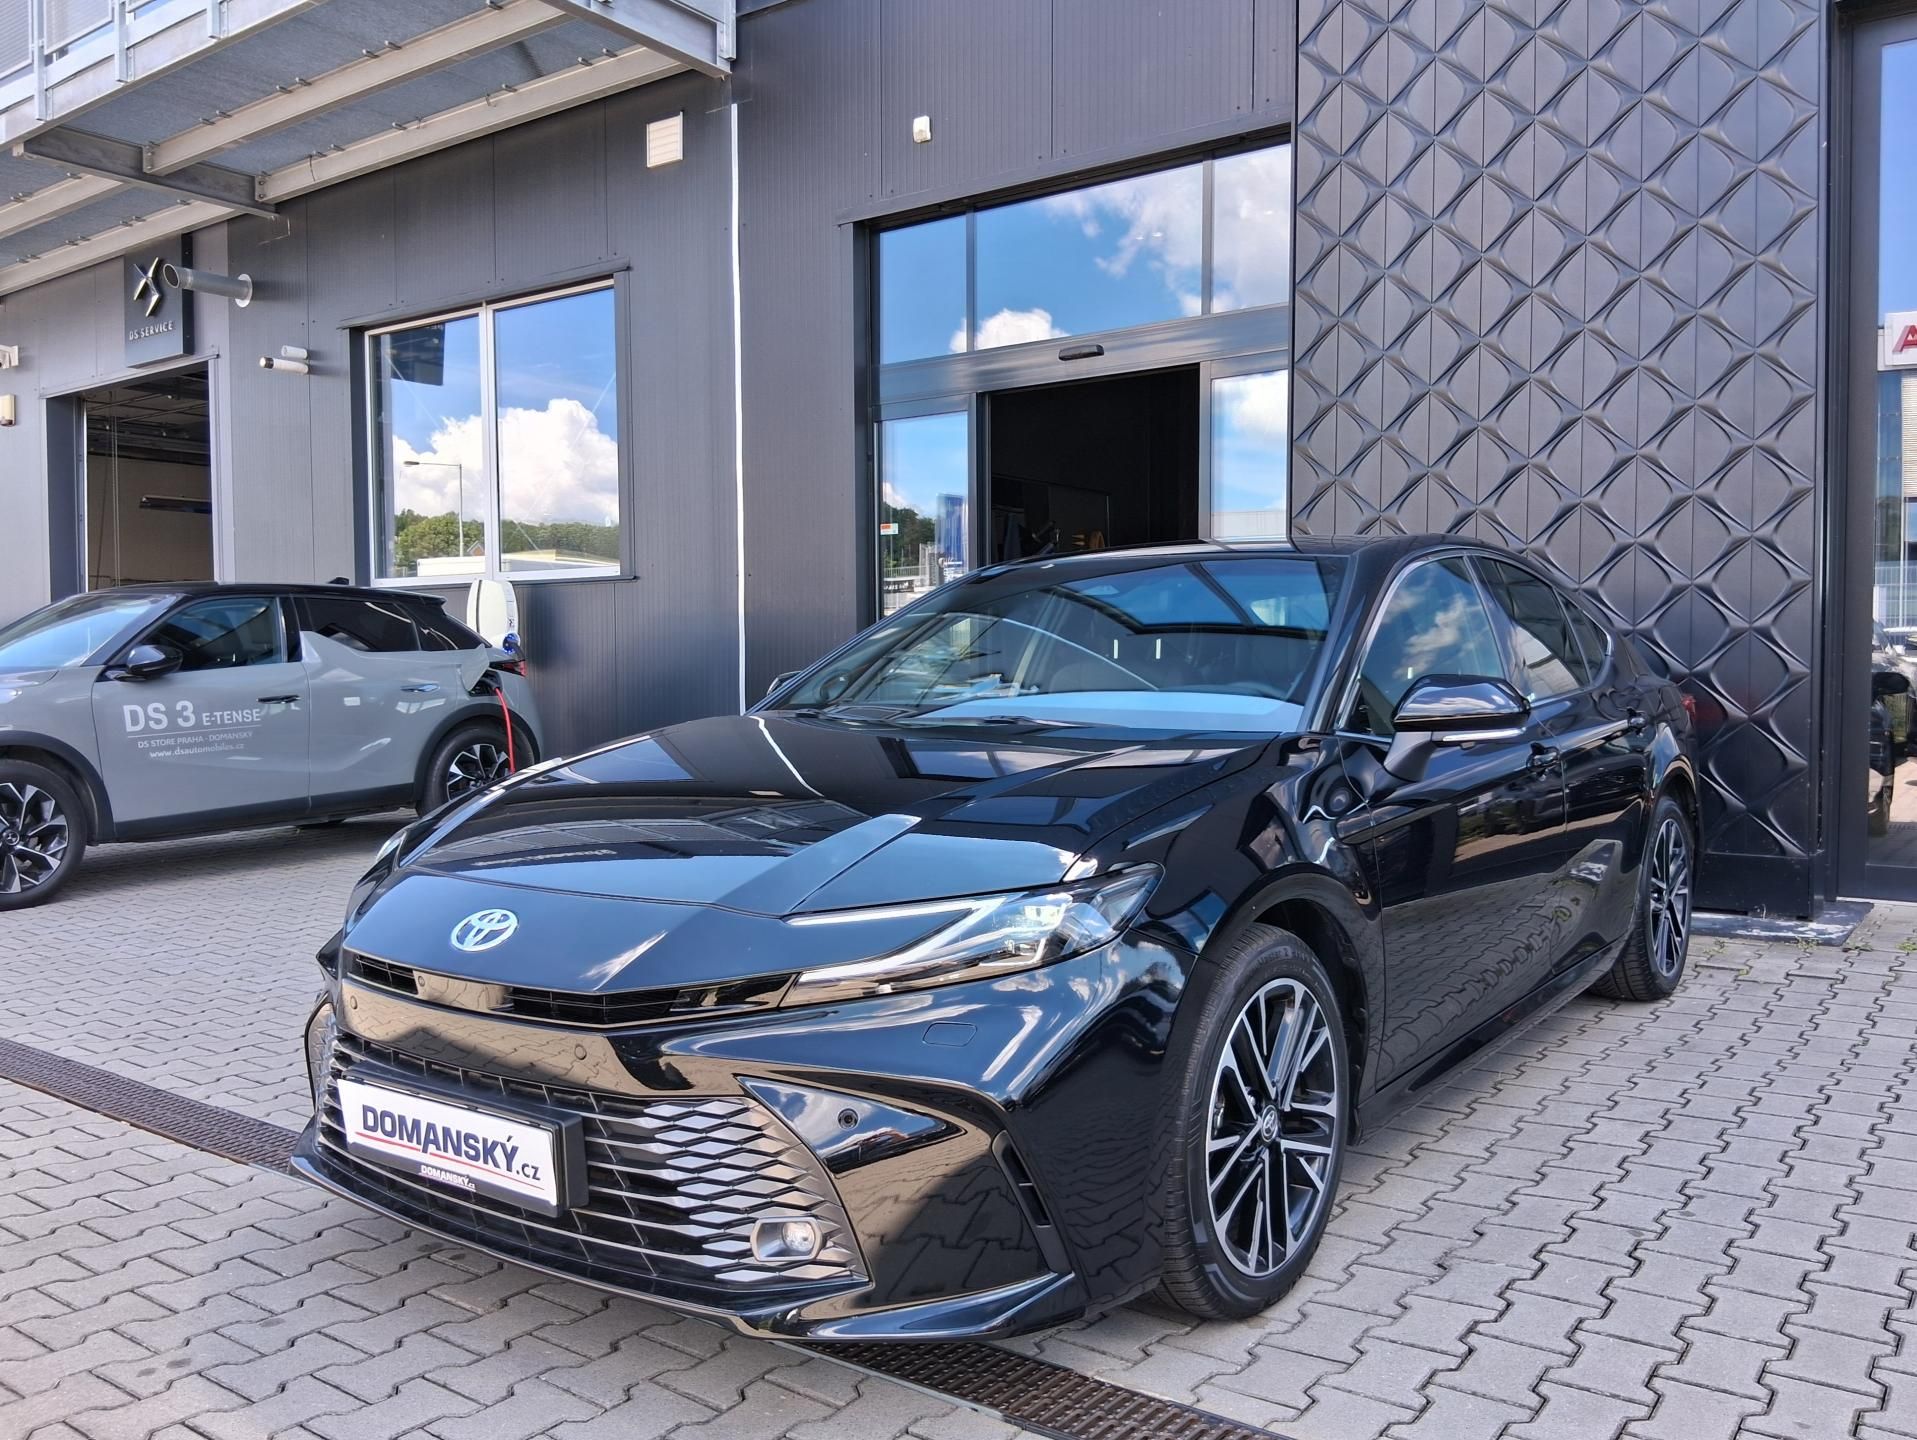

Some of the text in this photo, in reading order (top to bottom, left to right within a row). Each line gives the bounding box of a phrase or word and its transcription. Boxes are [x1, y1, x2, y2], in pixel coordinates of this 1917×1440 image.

[129, 320, 173, 341] DS SERVICE
[123, 700, 262, 732] DS 3 E-TENSE
[138, 741, 150, 749] DS
[150, 738, 176, 748] STORE
[177, 735, 203, 744] PRAHA
